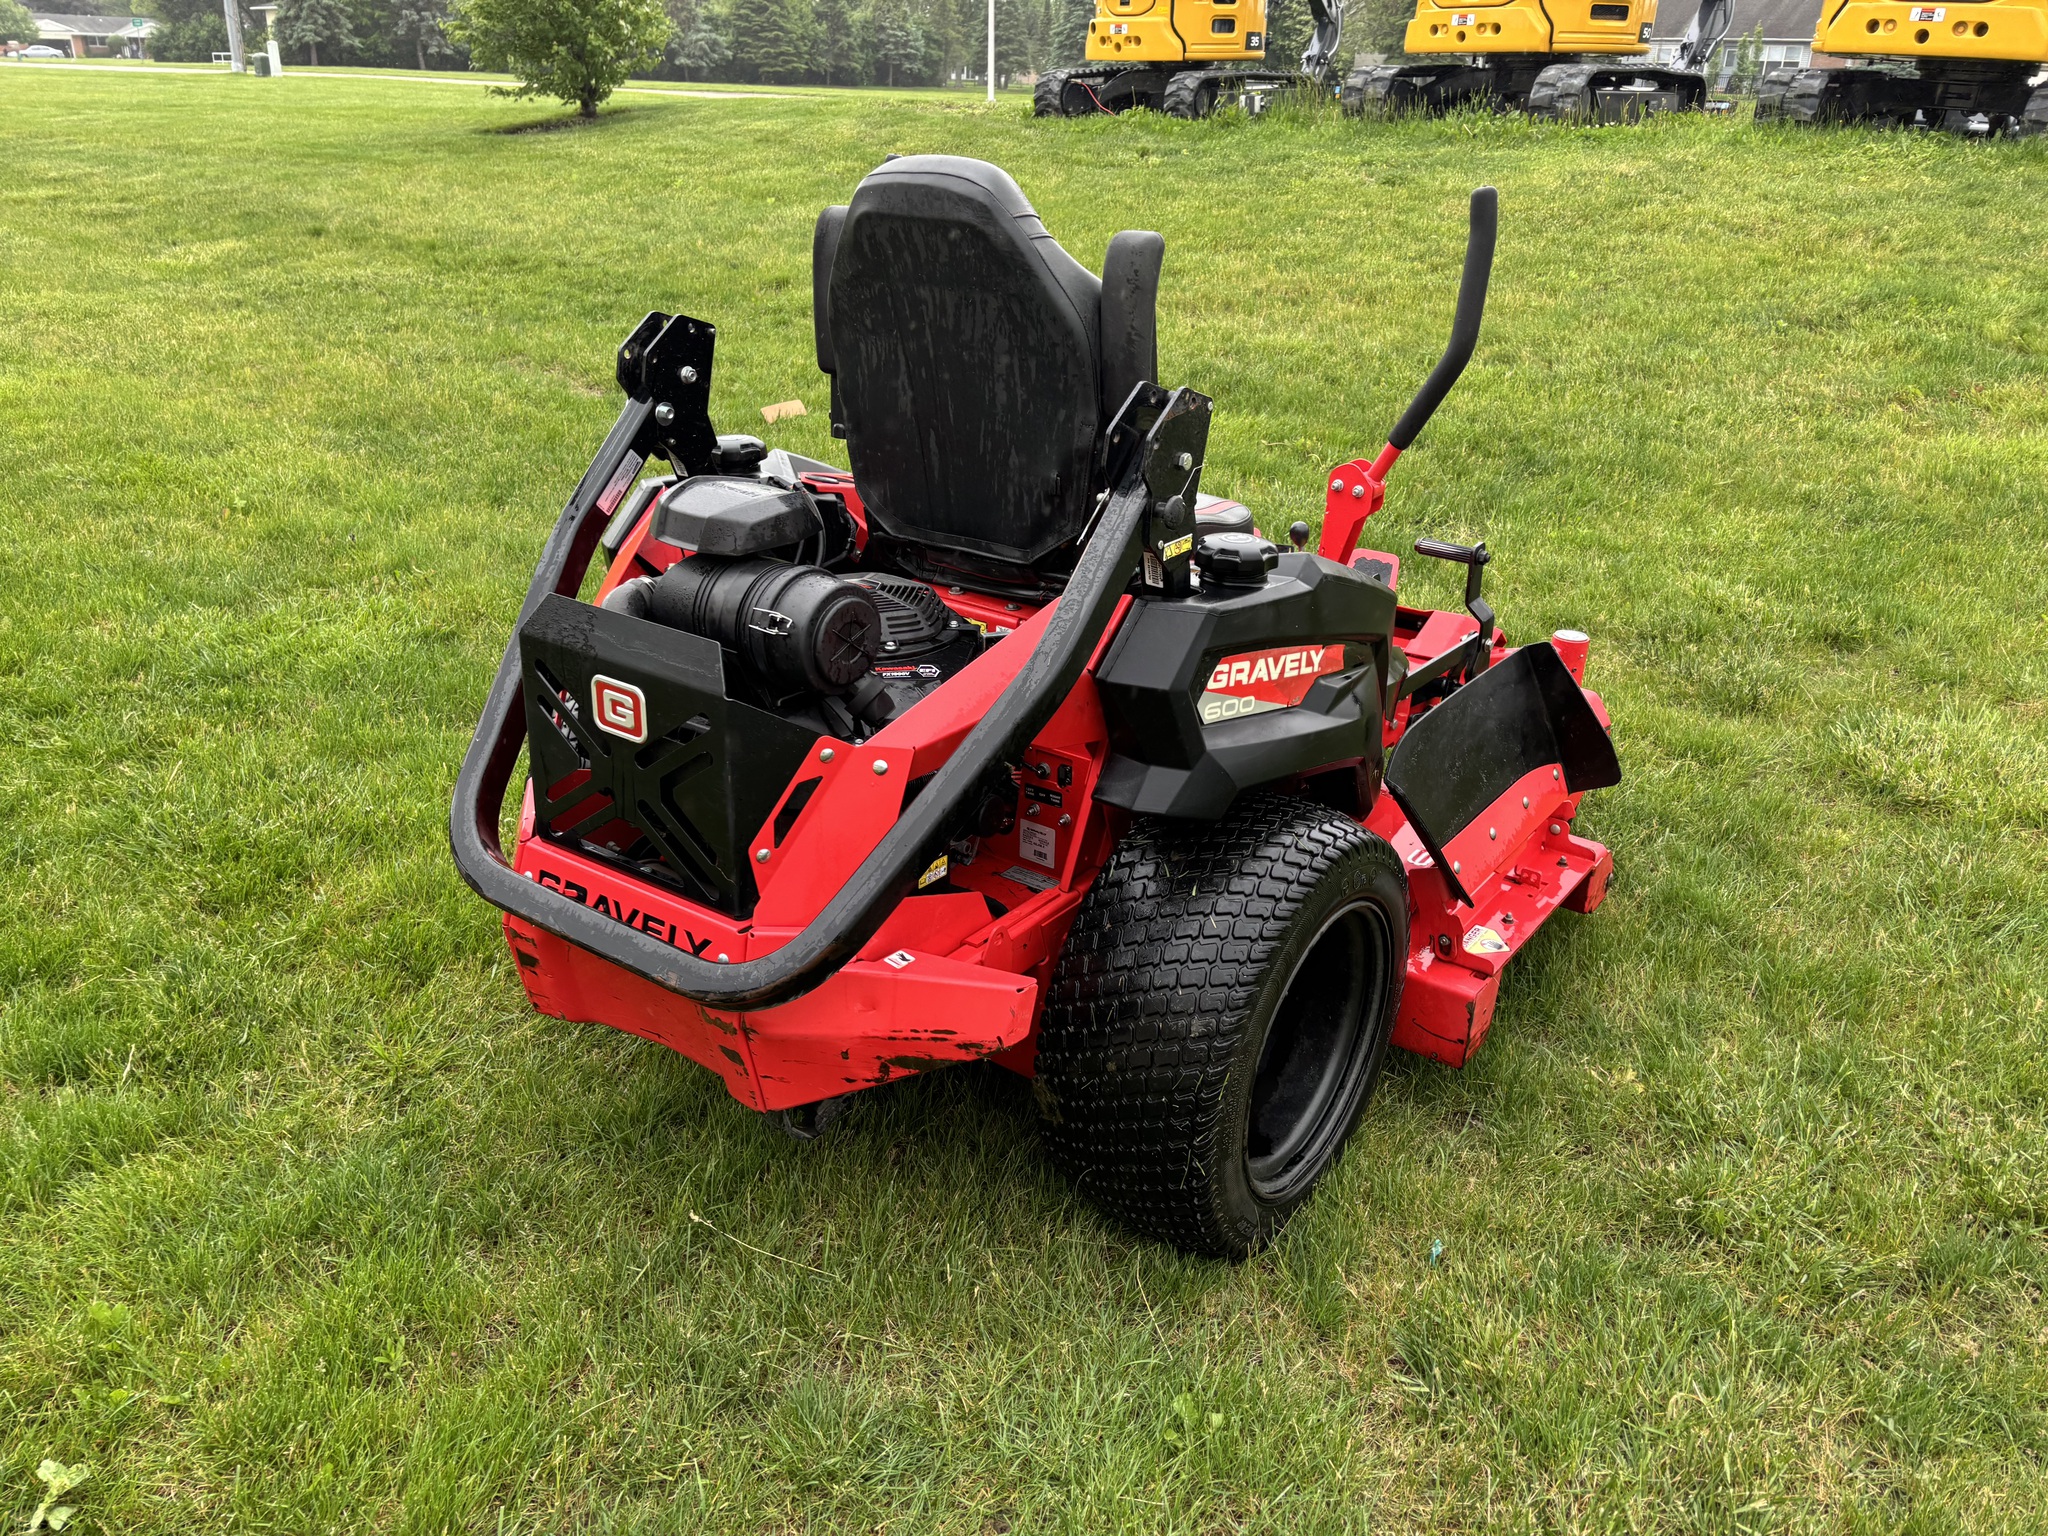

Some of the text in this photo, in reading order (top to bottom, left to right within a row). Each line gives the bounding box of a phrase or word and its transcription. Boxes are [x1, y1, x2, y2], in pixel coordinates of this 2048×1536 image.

[1250, 36, 1260, 47] 35
[1642, 27, 1652, 39] 50
[1207, 648, 1325, 690] GRAVELY
[603, 688, 636, 730] G
[1204, 696, 1256, 721] 600
